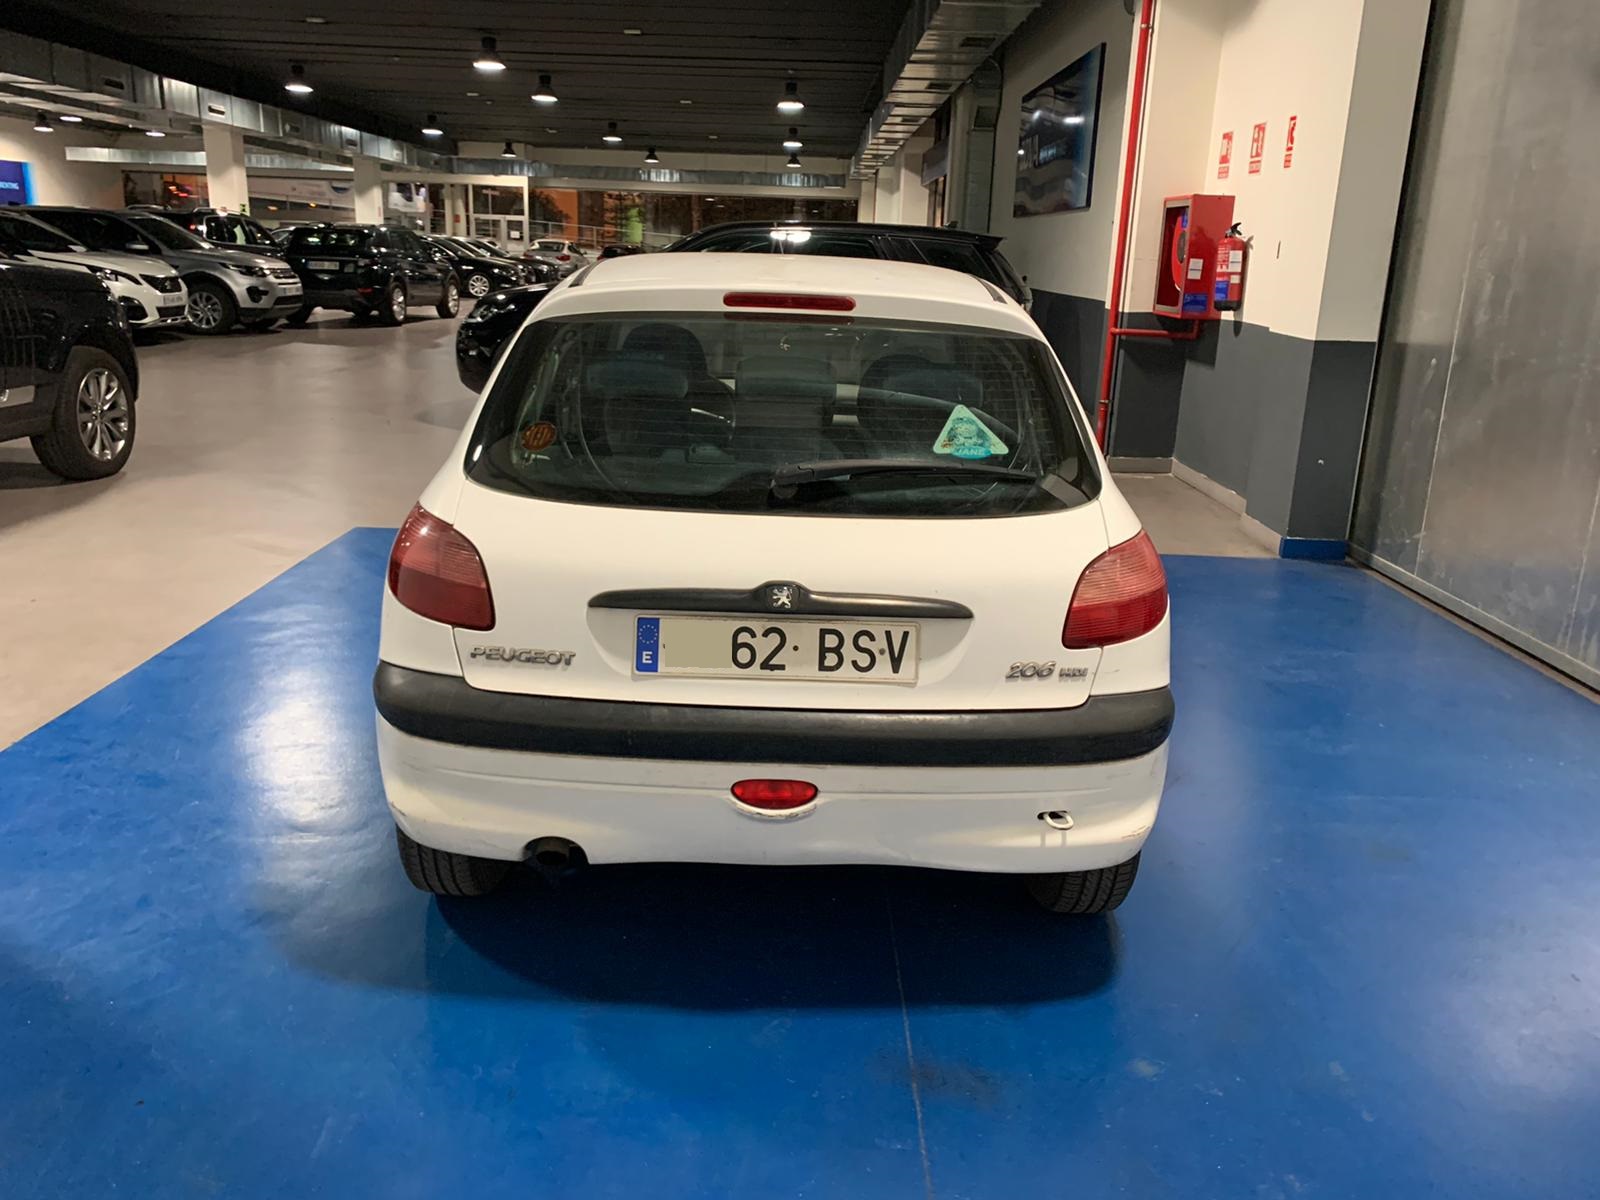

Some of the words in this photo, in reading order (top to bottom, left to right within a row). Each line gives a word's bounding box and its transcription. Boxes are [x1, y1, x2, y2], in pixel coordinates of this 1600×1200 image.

[470, 645, 577, 666] PEUGEOT
[642, 651, 653, 664] E
[818, 628, 910, 674] BSV
[1005, 661, 1057, 679] 206
